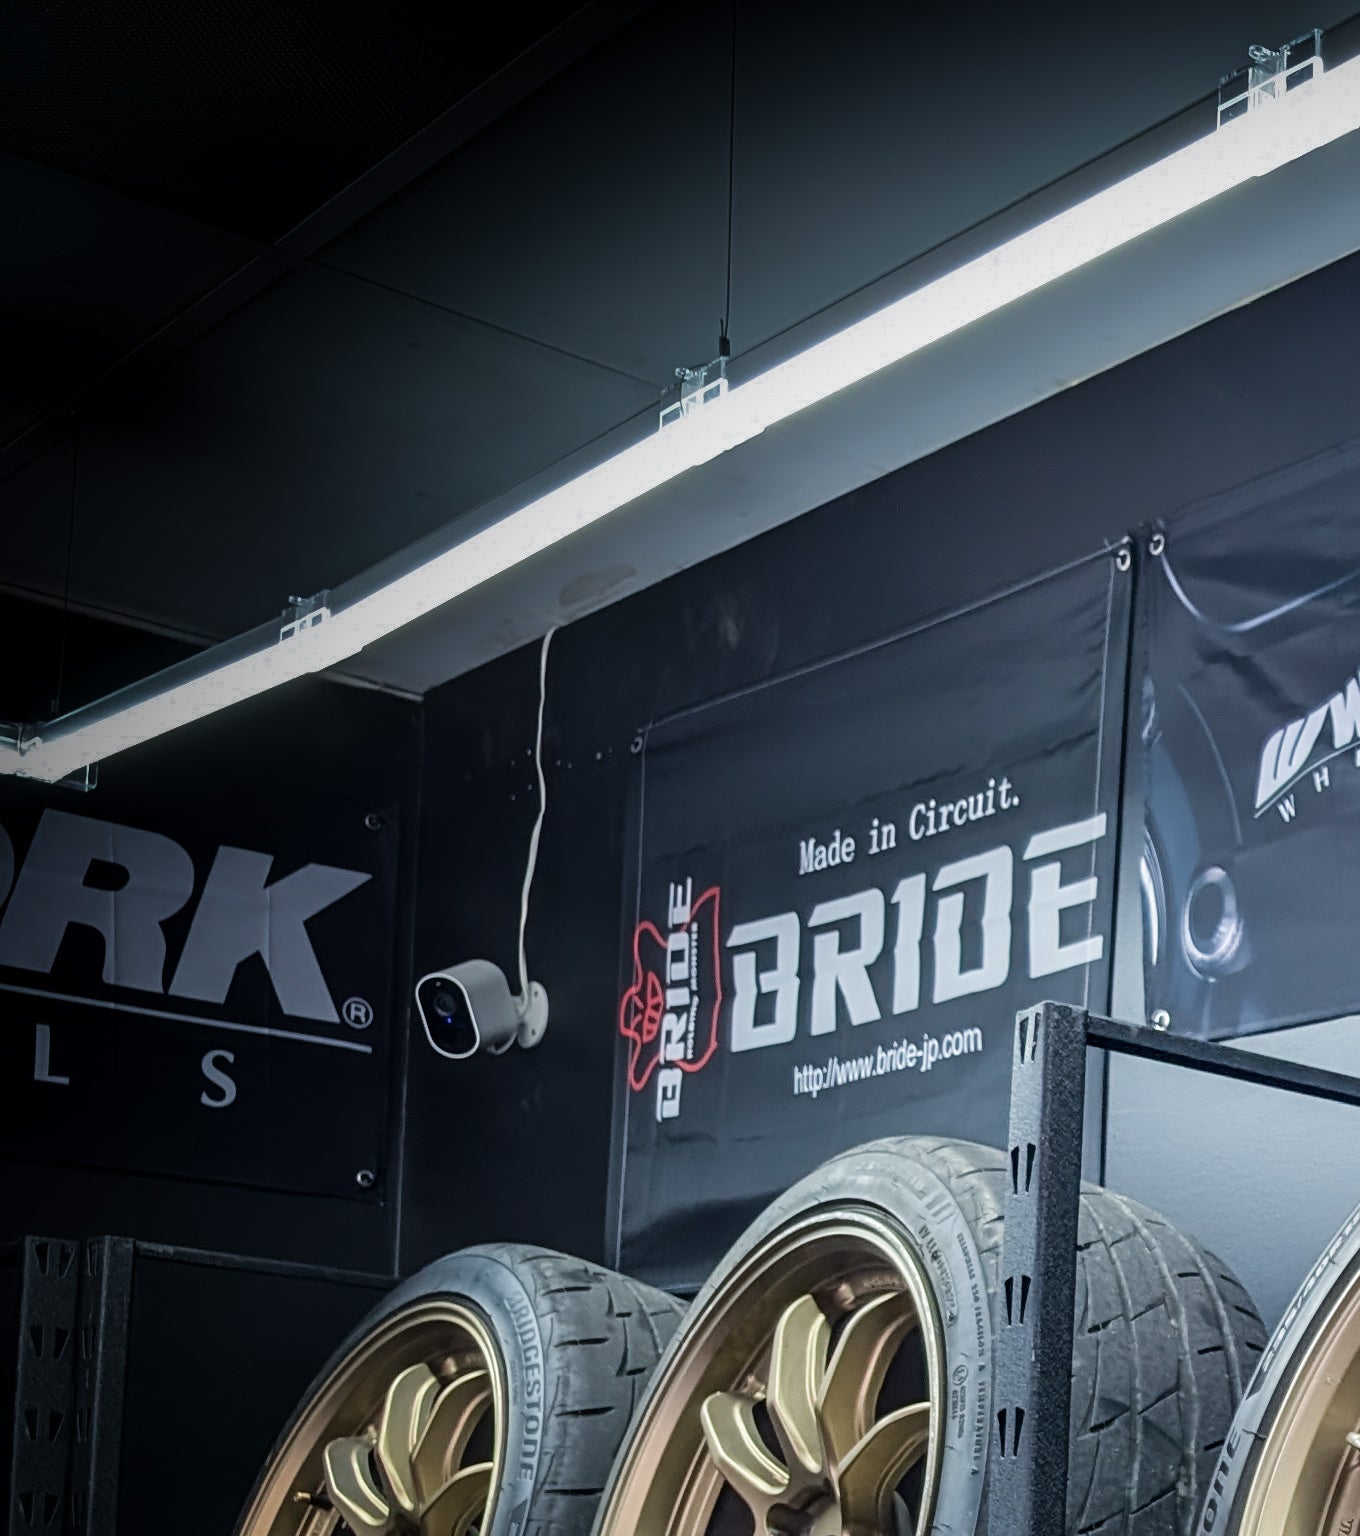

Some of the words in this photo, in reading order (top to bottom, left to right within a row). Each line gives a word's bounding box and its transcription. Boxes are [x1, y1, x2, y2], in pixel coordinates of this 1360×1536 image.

[799, 838, 855, 877] Made
[868, 819, 897, 854] in
[908, 777, 1021, 843] Circuit.
[655, 876, 692, 1123] BRIDE
[726, 812, 1107, 1052] BRIDE
[793, 1023, 982, 1095] http://www.bride-jp.com
[508, 1291, 544, 1484] BRIDGESTONE
